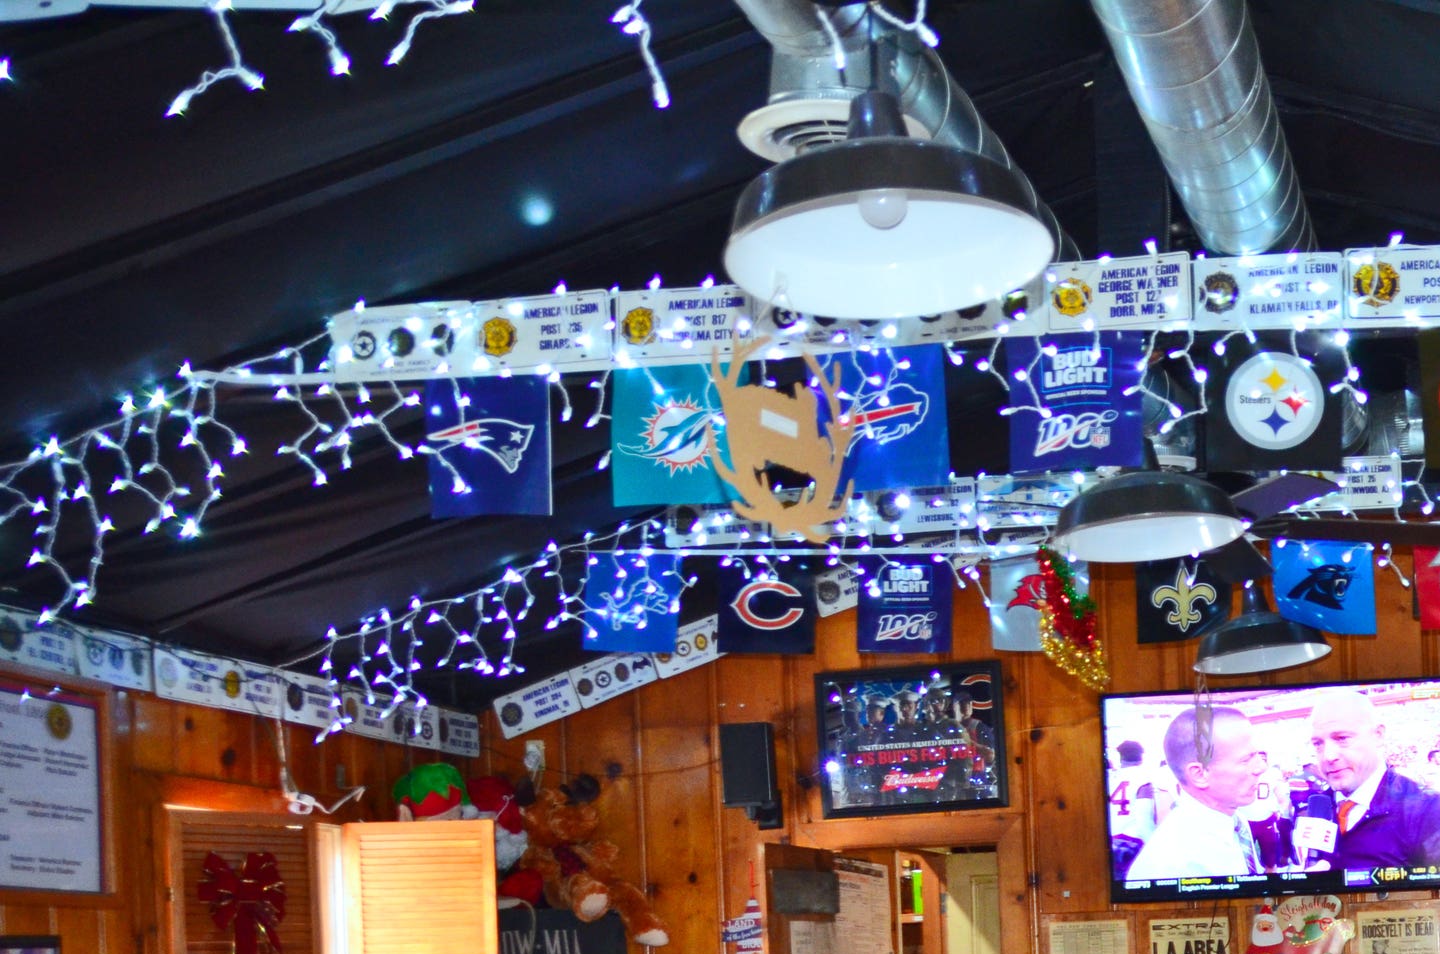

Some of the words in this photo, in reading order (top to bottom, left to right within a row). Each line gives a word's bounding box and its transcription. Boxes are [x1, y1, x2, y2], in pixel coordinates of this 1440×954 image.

[1101, 266, 1148, 280] AMERICAN
[1304, 263, 1338, 274] LEGION
[1098, 280, 1136, 293] GEORGE
[1115, 292, 1139, 304] POST
[1404, 294, 1440, 305] NEWPORT
[712, 314, 727, 326] 817
[1053, 350, 1100, 371] BUD
[1045, 367, 1107, 388] LIGHT
[883, 581, 929, 593] LIGHT
[885, 742, 911, 750] STATES
[884, 773, 940, 786] Budweiser
[728, 919, 756, 928] LAND
[1362, 923, 1402, 939] ROOSEVELT
[1404, 923, 1413, 937] IS
